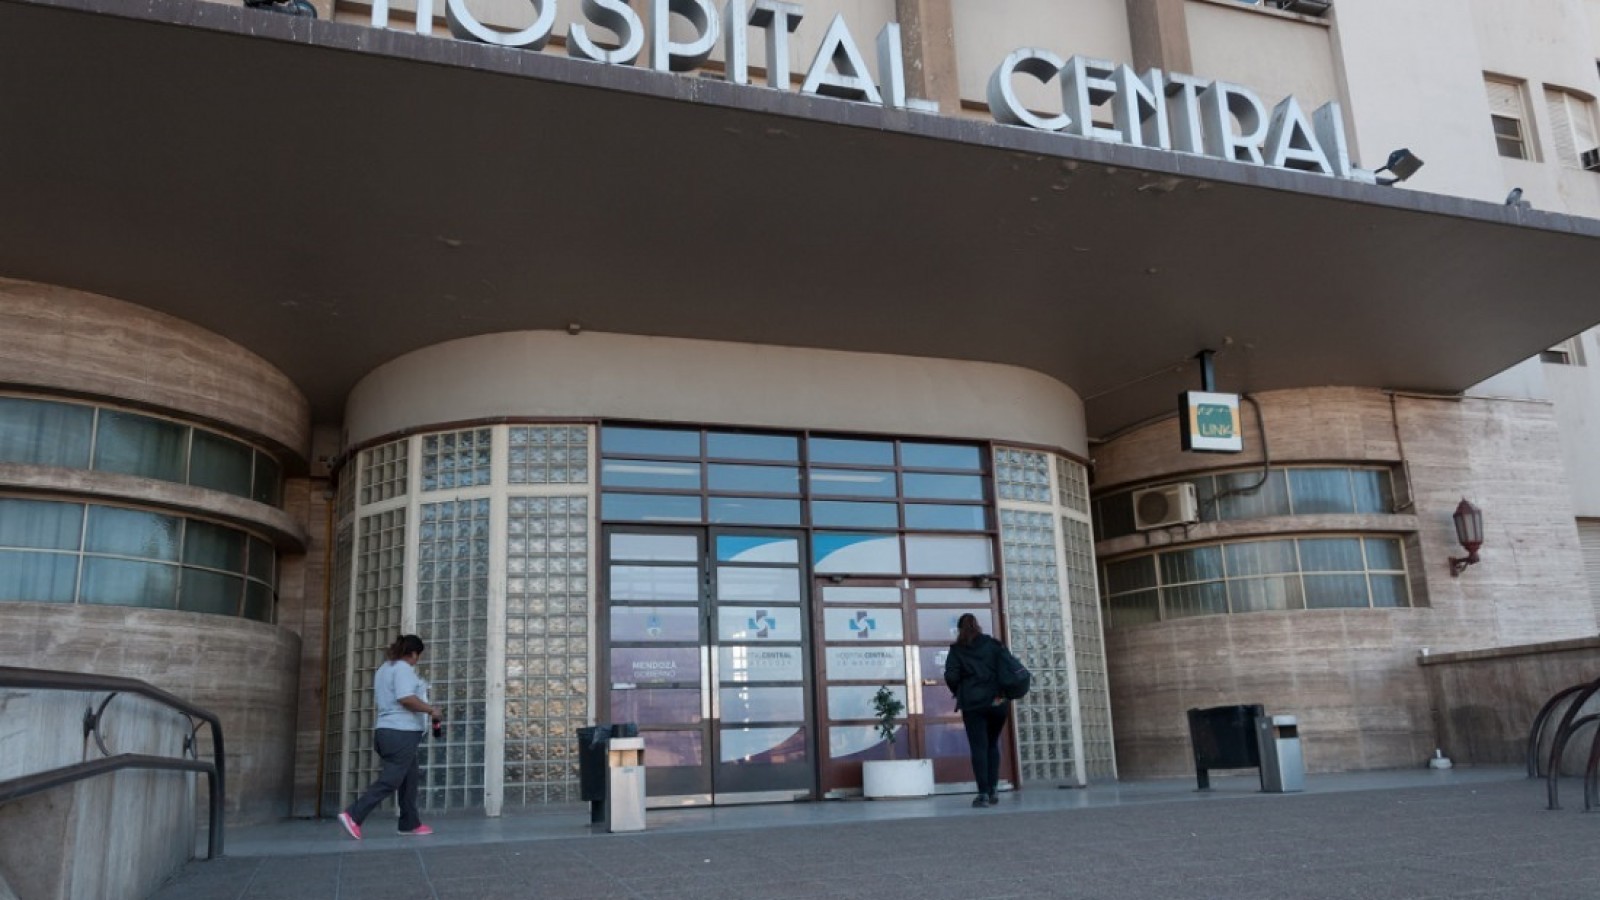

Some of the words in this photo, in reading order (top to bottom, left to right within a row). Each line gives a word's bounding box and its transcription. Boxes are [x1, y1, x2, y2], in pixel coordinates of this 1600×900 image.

[987, 46, 1376, 185] CENTRAL
[1202, 422, 1232, 436] LINK
[632, 660, 677, 669] MENDOZA
